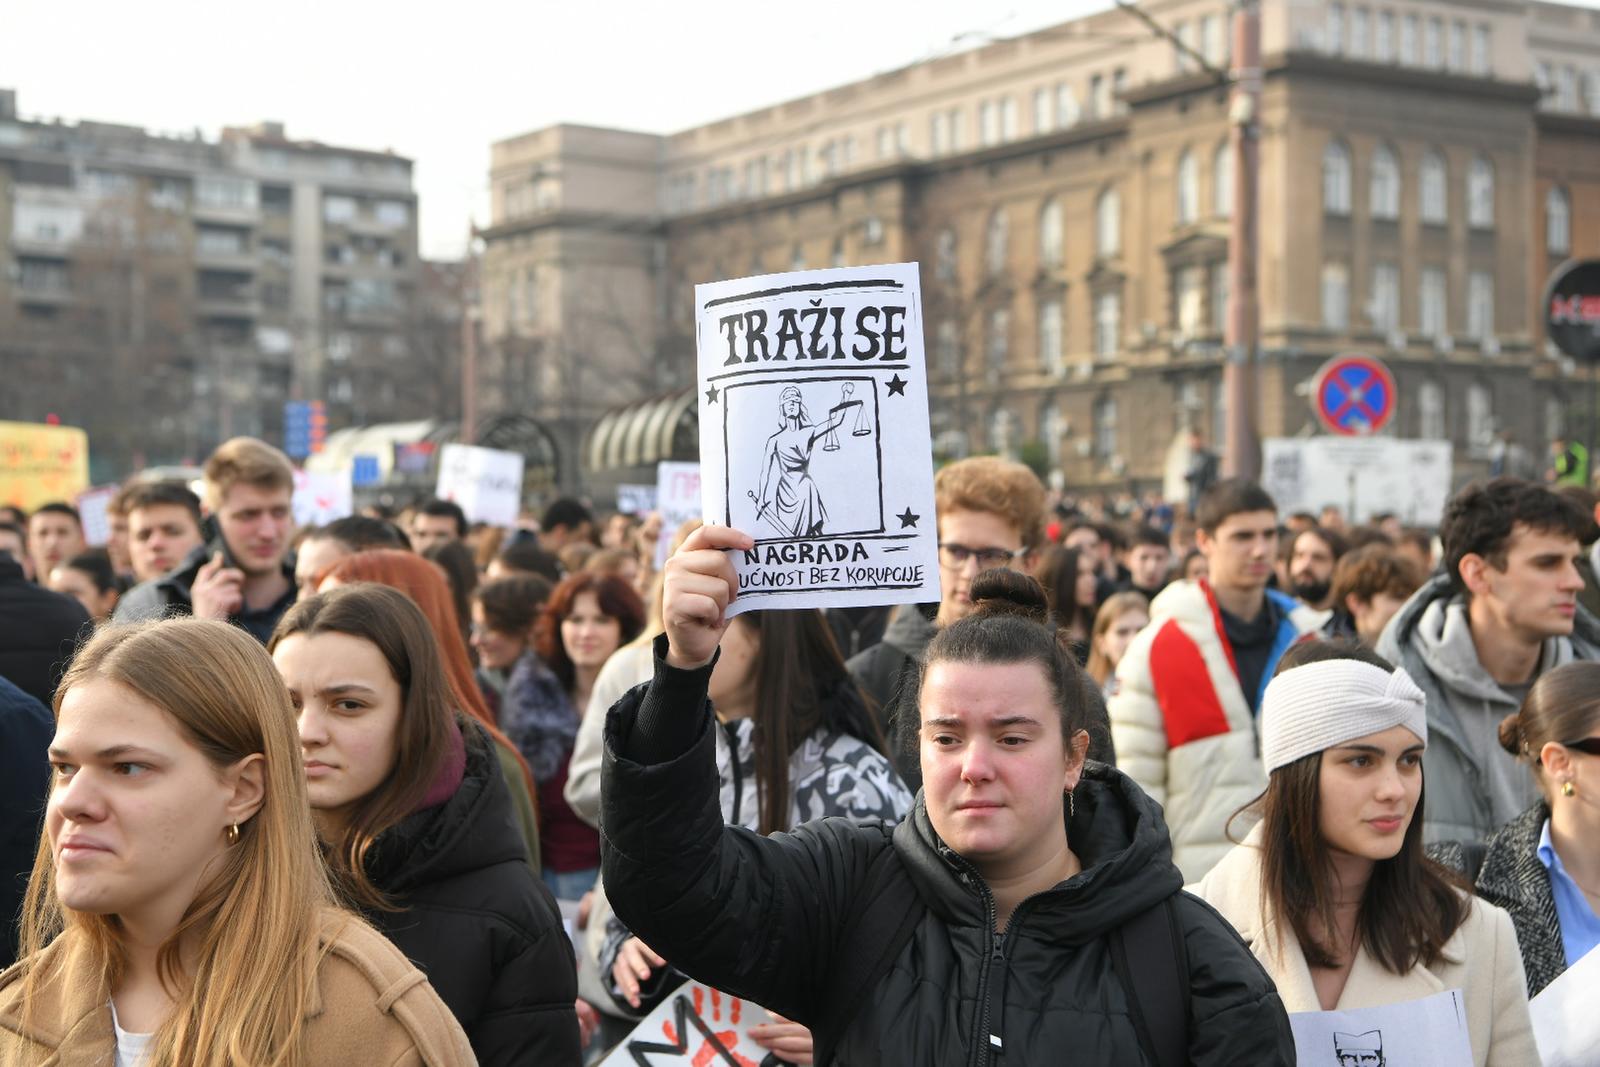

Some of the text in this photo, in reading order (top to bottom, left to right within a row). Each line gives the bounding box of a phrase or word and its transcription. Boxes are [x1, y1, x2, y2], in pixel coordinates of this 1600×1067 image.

[719, 298, 907, 367] TRAŽI SE
[744, 542, 869, 565] NAGRADA
[738, 564, 924, 588] UĆNOST BEZ KORUPCIJE
